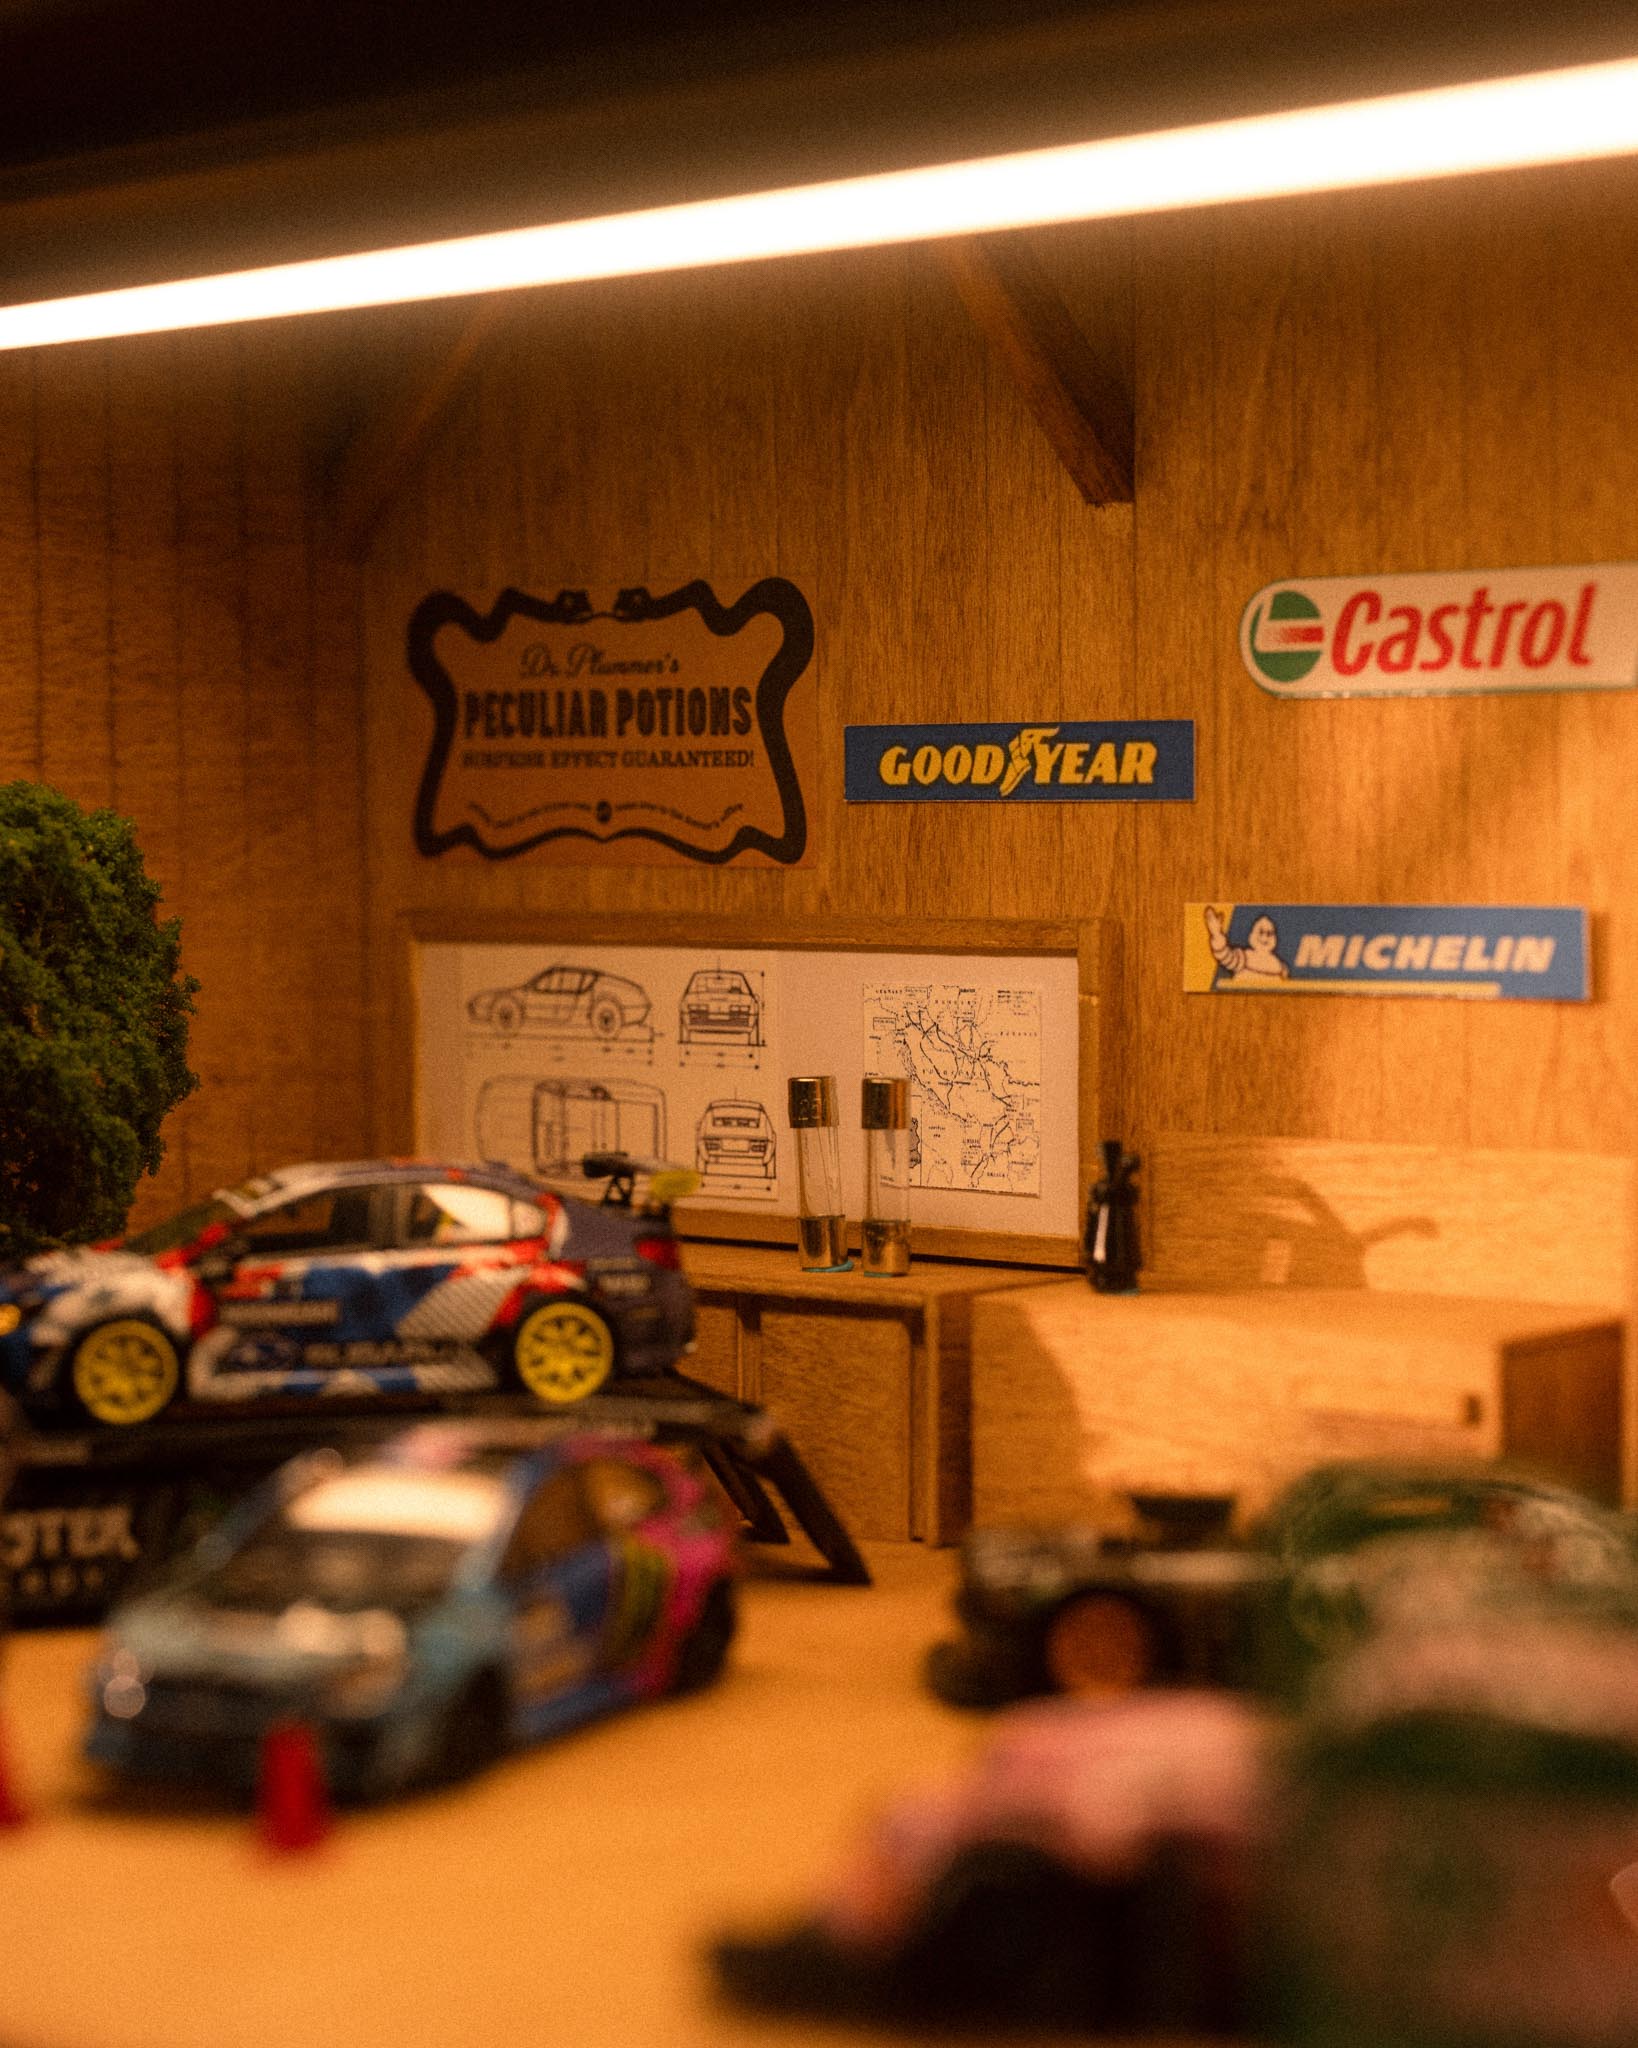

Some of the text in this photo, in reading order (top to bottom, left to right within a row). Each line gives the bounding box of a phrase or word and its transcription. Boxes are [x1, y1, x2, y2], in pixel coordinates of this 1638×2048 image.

[1332, 582, 1597, 676] Castrol
[465, 686, 752, 738] PECULIAR POTIONS
[621, 748, 755, 768] GUARANTEED!
[1294, 934, 1556, 973] MICHELIN
